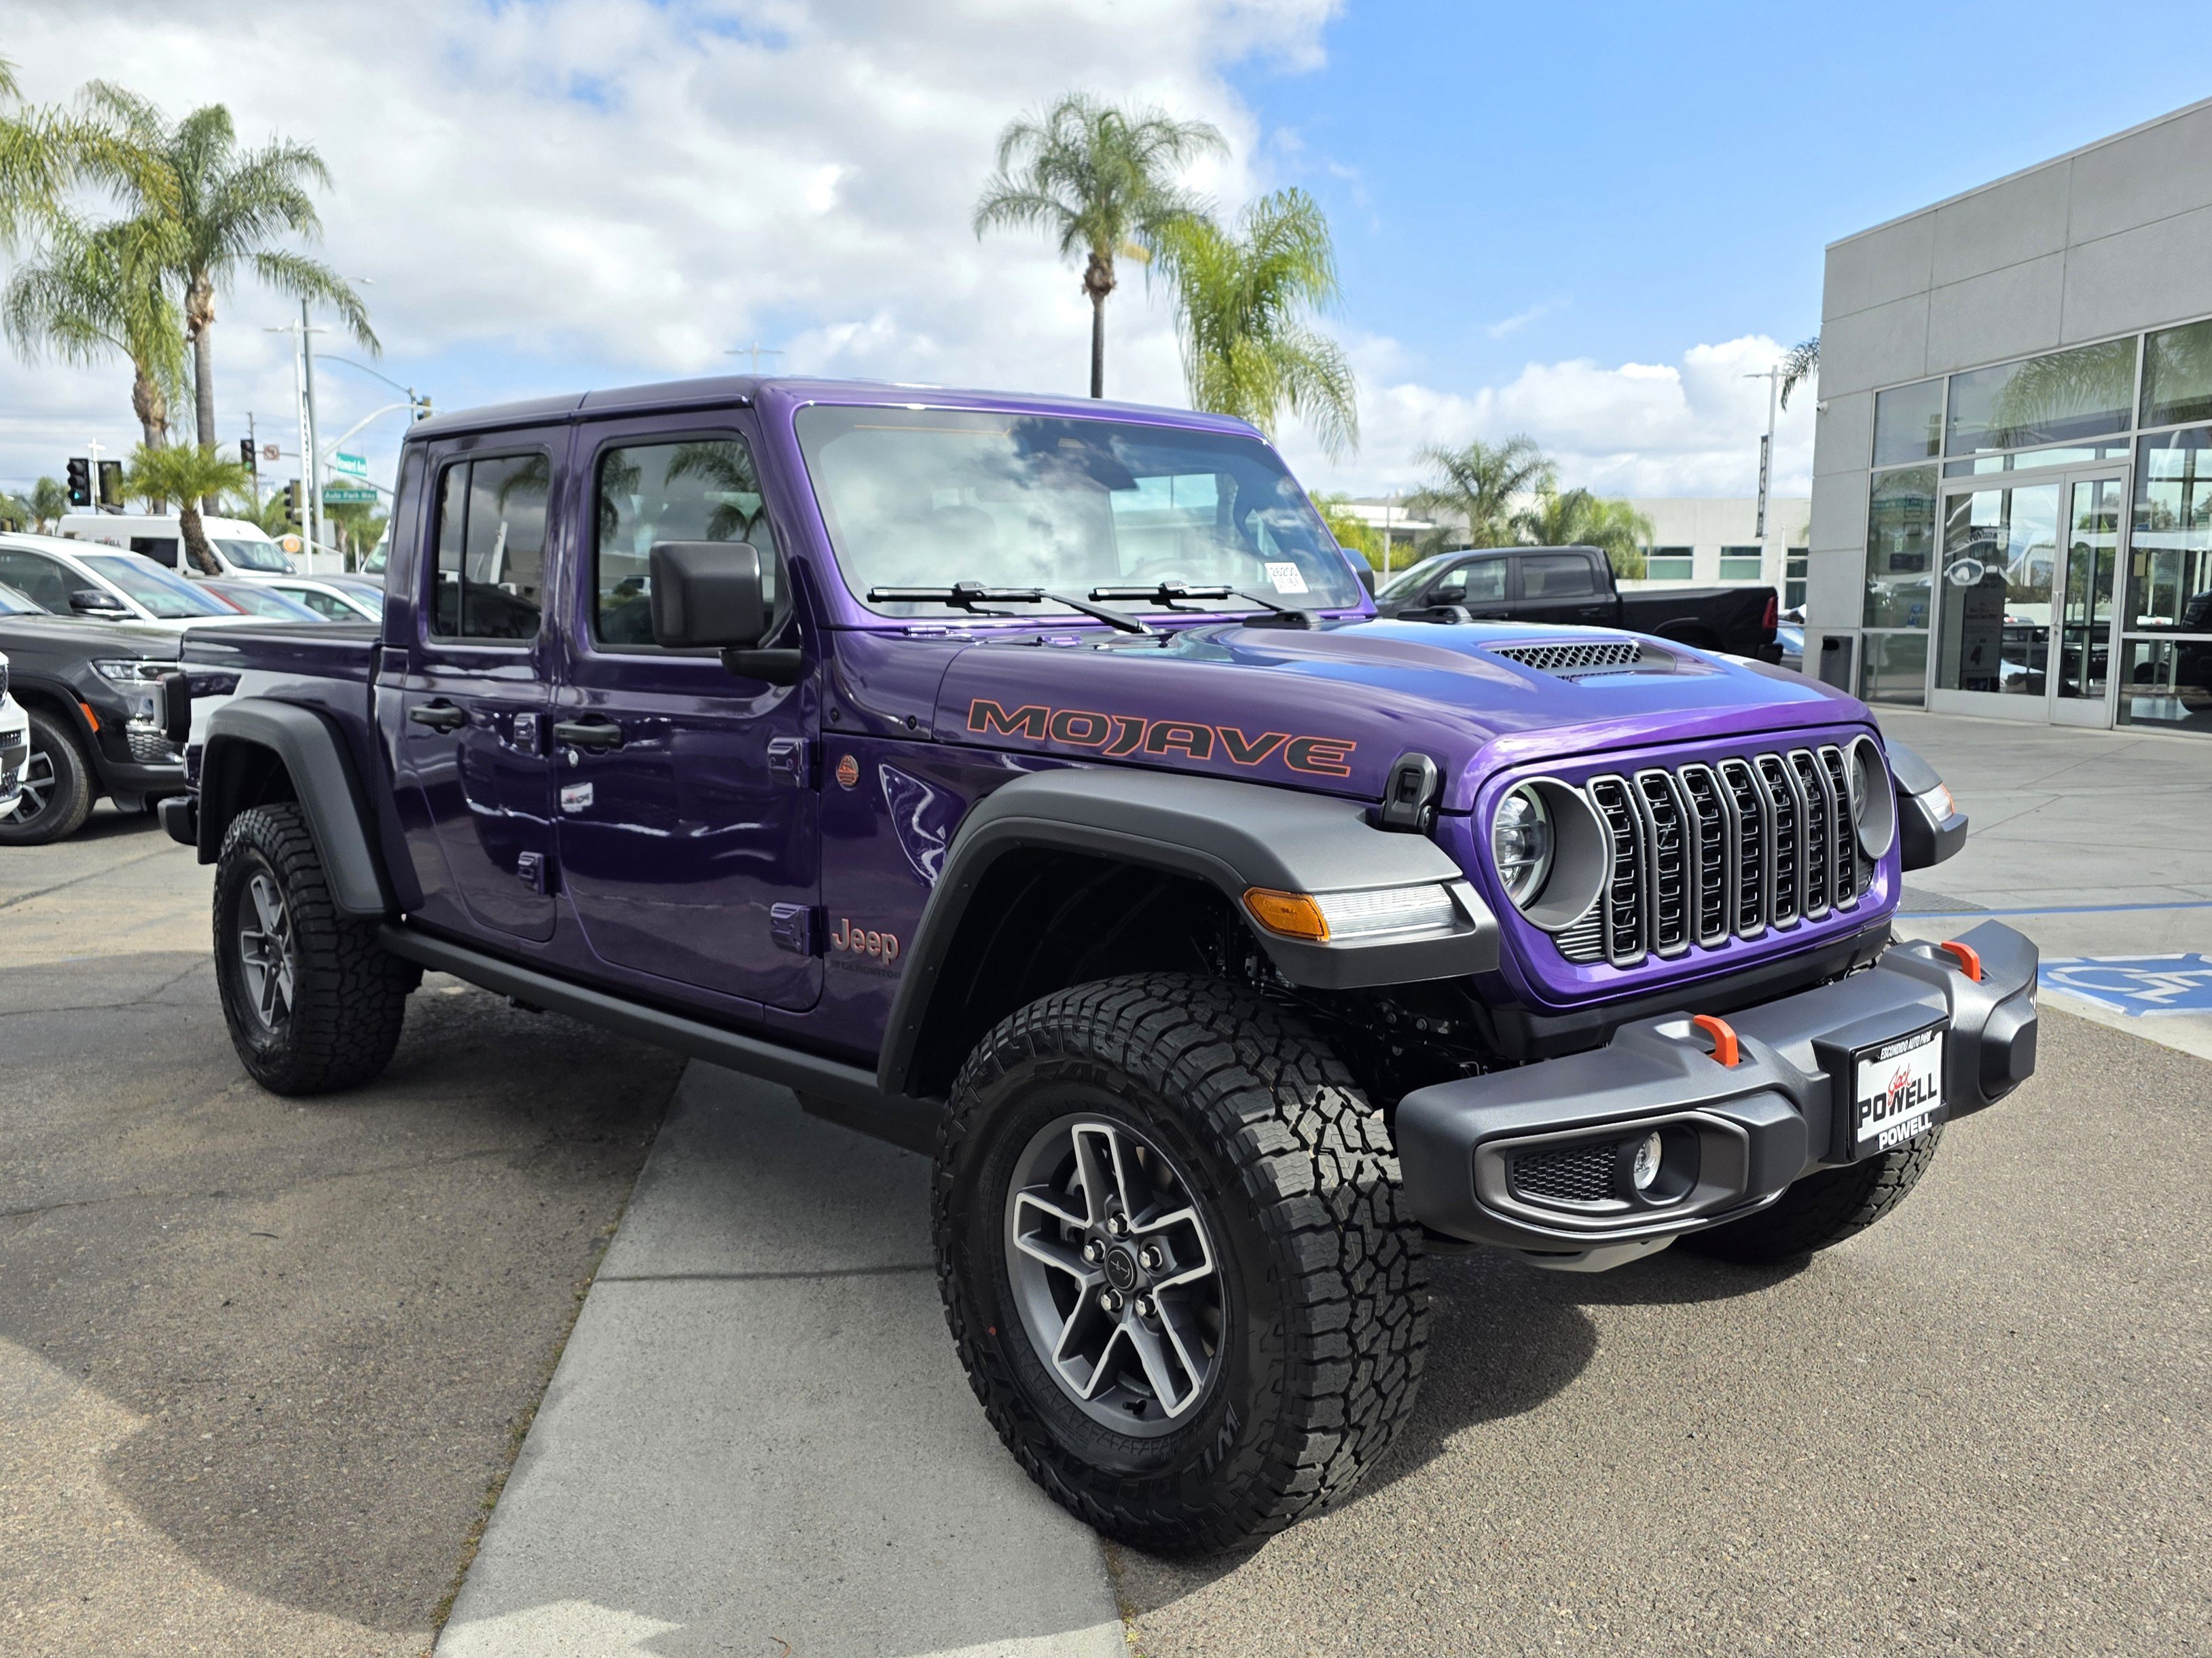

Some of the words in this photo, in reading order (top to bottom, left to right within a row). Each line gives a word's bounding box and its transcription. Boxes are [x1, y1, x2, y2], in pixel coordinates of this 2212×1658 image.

[357, 460, 367, 475] Ave
[325, 491, 342, 499] Auto
[343, 491, 360, 499] Park
[361, 491, 376, 500] Way
[966, 699, 1357, 777] MOJAVE
[832, 918, 899, 966] Jeep
[1880, 1039, 1909, 1060] ESCONDIDO
[1908, 1035, 1921, 1051] AUTO
[1920, 1030, 1933, 1046] PARK
[1857, 1072, 1938, 1129] POWELL
[1888, 1063, 1913, 1107] Jack
[1879, 1112, 1933, 1151] POWELL
